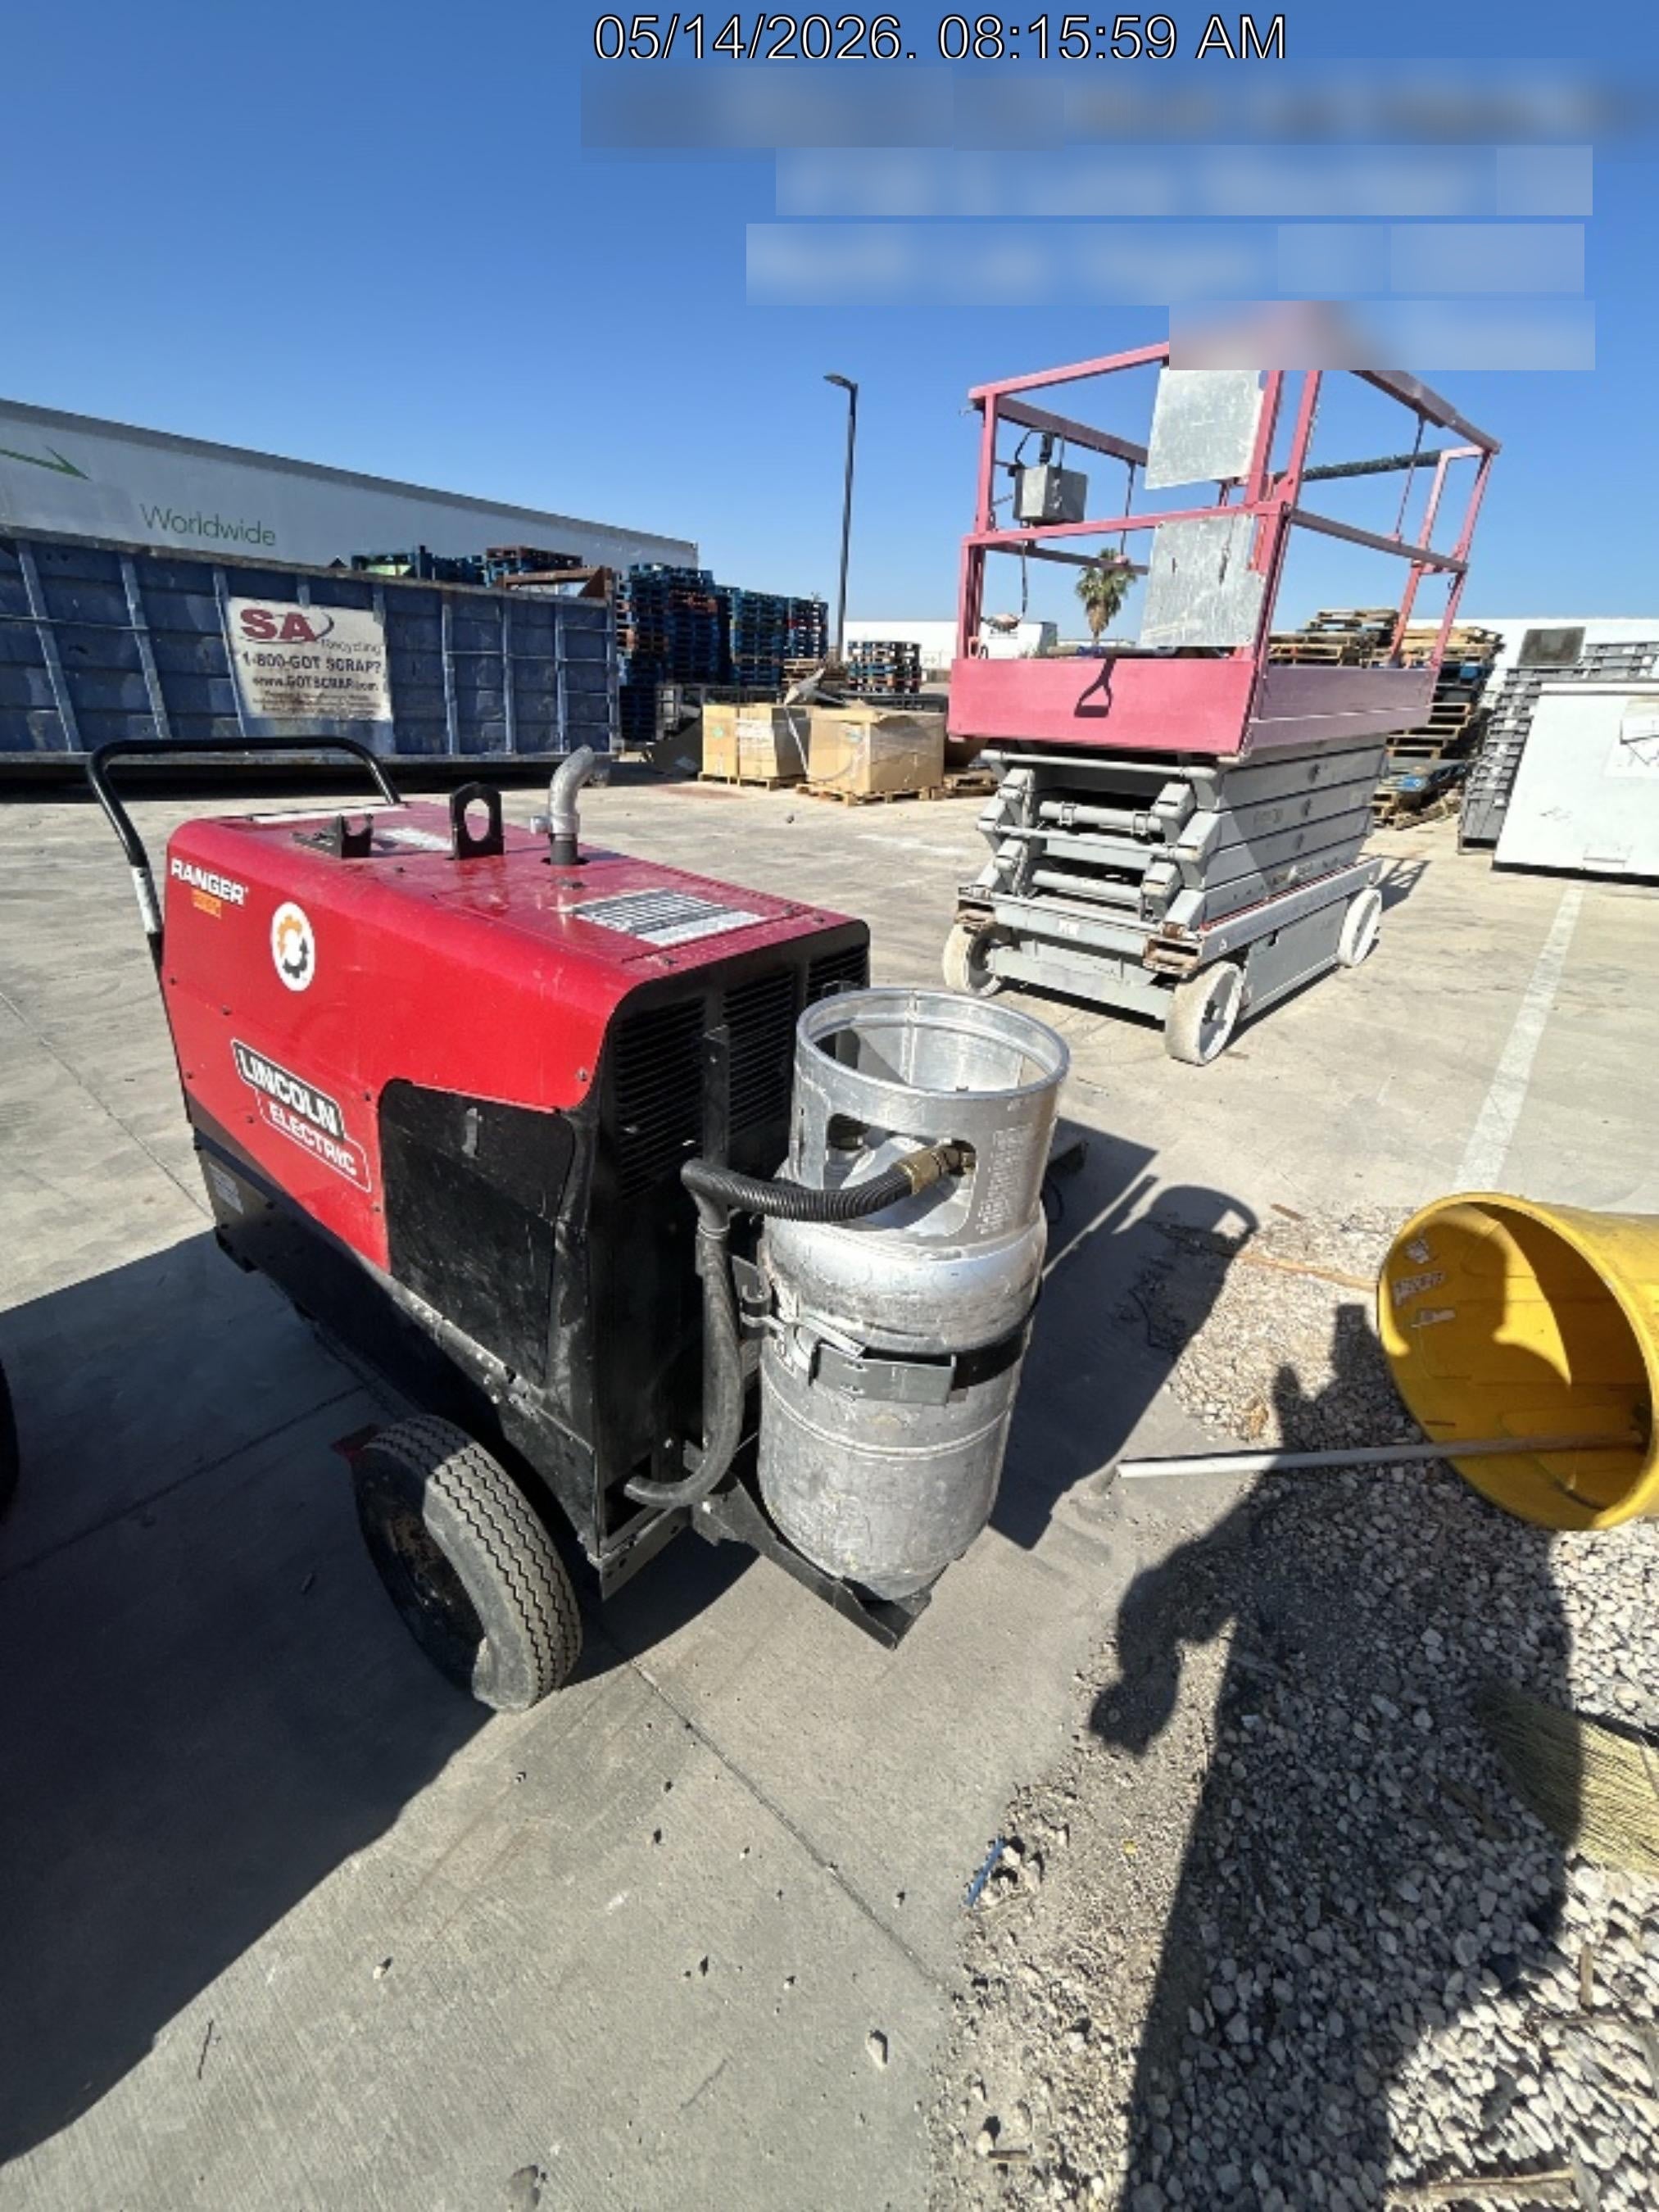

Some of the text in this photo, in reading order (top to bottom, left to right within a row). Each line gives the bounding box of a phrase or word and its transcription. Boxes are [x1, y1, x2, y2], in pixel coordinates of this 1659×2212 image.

[138, 503, 276, 546] Worldwide
[240, 608, 316, 642] SA
[243, 651, 382, 674] 1-800-GOT SCRAP?
[171, 857, 245, 906] RANGER
[238, 1048, 340, 1136] LINCOLN
[268, 1100, 357, 1176] ELECTRIC
